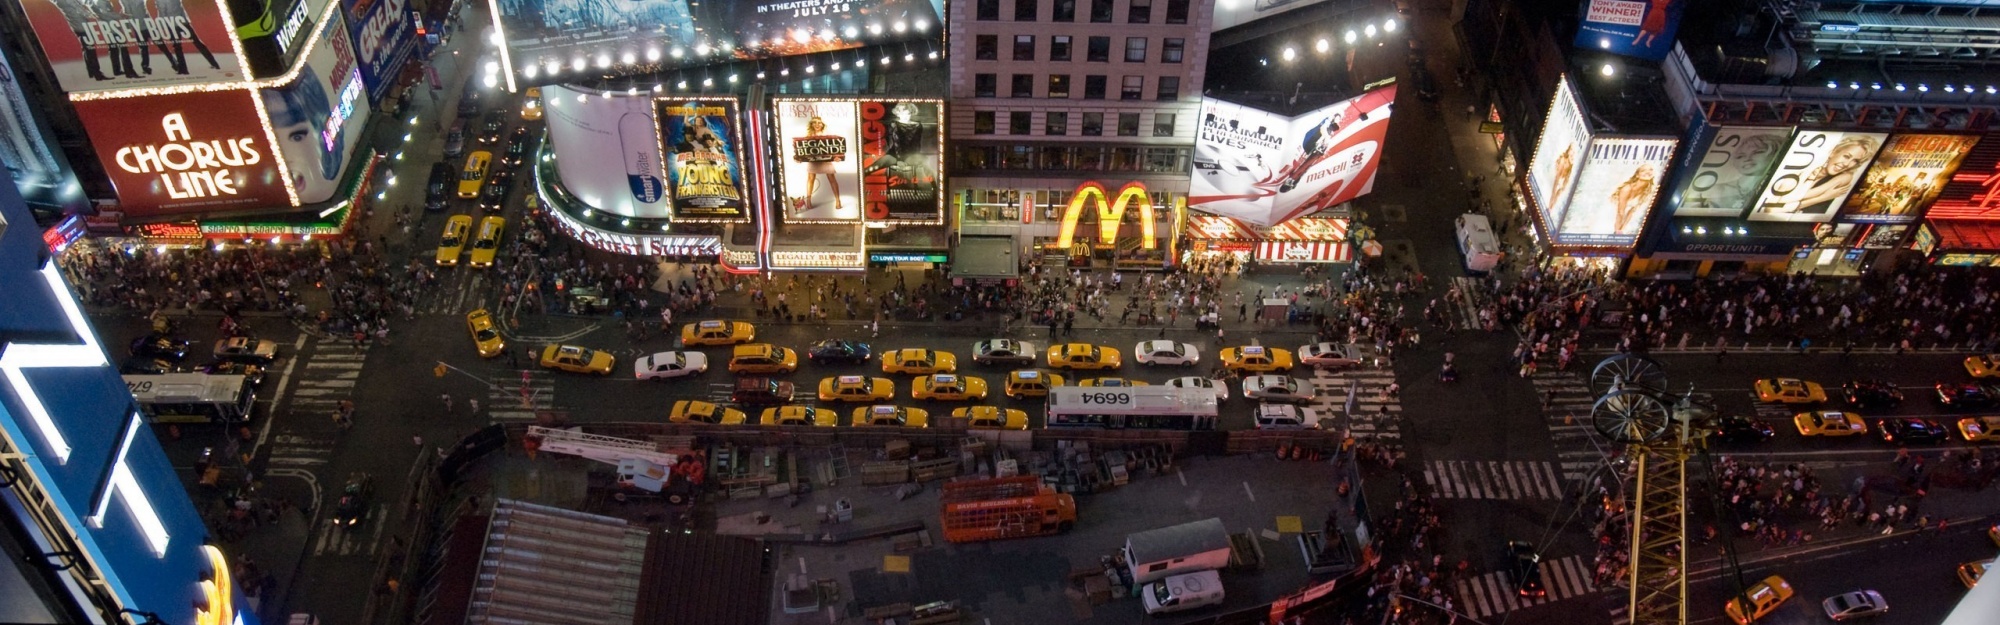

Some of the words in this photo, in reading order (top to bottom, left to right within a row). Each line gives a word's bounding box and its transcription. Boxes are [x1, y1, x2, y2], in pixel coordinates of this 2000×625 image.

[757, 5, 768, 13] IN
[771, 1, 820, 12] THEATERS
[793, 7, 827, 18] JULY
[833, 3, 850, 13] 18
[1592, 6, 1641, 17] WINNER!
[1617, 1, 1643, 9] AWARD
[82, 18, 144, 46] JERSEY
[144, 15, 191, 41] BOYS
[162, 112, 191, 142] A
[795, 138, 845, 149] LEGALLY
[1202, 132, 1246, 149] LIVES
[1893, 134, 1975, 153] HEIGHTS
[115, 137, 261, 174] CHORUS
[797, 146, 846, 156] BLONDE
[1593, 144, 1639, 160] MAMMA
[1306, 160, 1347, 183] maxell
[1912, 160, 1947, 168] MUSICAL
[637, 151, 656, 203] smartwater
[678, 162, 733, 187] YOUNG
[1757, 133, 1826, 213] TOUS
[160, 169, 238, 199] LINE
[677, 184, 740, 199] FRANKENSTEIN
[1686, 243, 1766, 252] OPPORTUNITY
[1081, 392, 1130, 404] 6694
